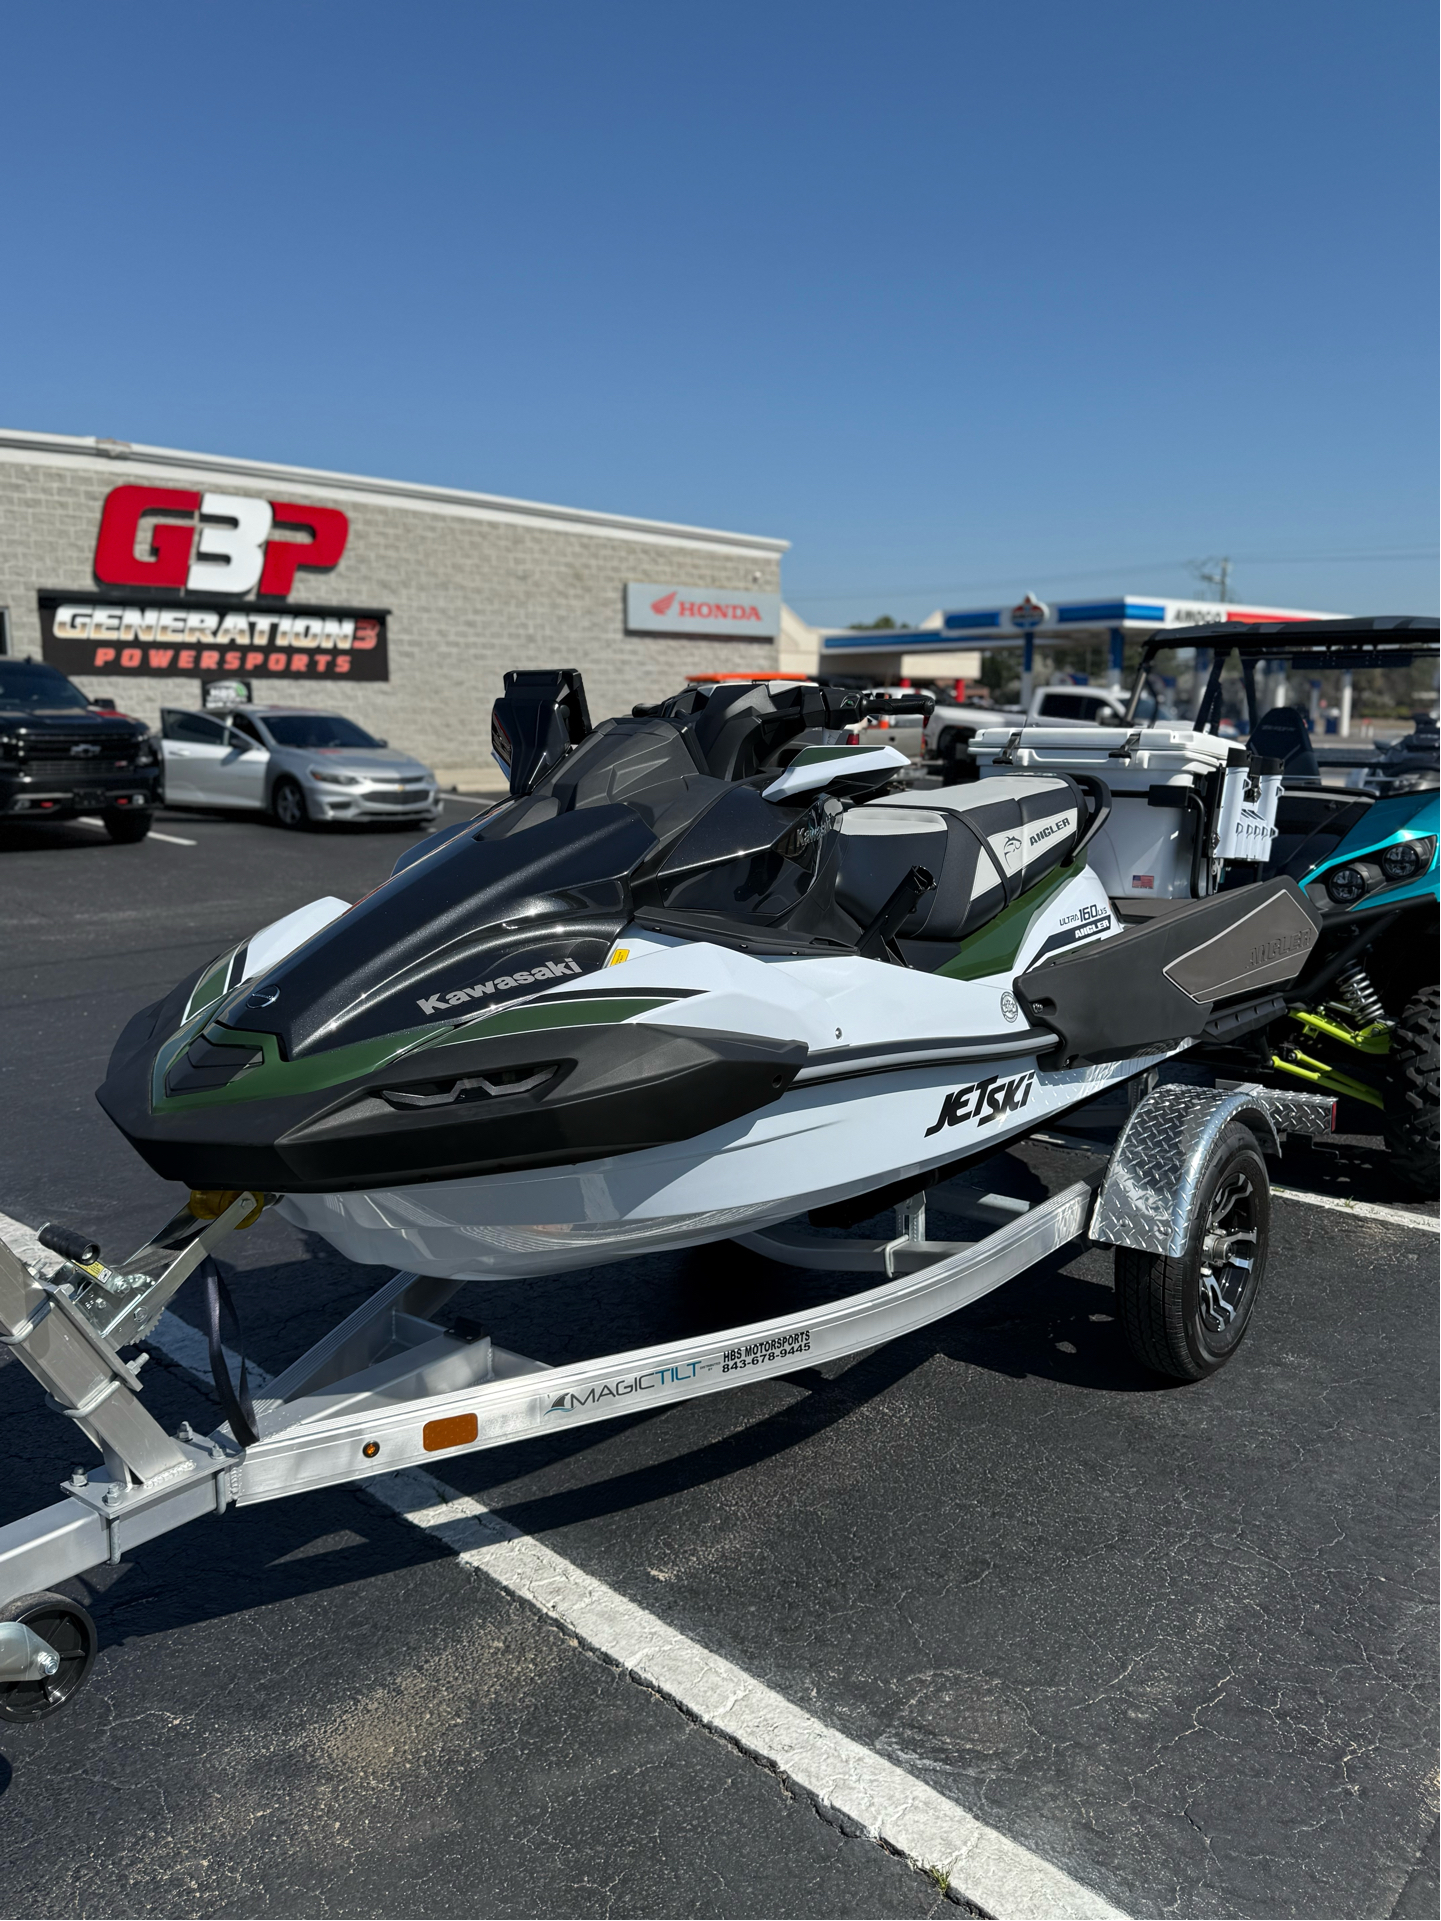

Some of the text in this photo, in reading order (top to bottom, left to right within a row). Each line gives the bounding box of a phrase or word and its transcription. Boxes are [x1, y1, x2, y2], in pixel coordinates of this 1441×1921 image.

[94, 485, 349, 596] G3P
[678, 601, 762, 621] HONDA
[1172, 608, 1221, 625] AMOCO
[94, 647, 352, 673] POWERSPORTS
[1029, 817, 1070, 846] ANGLER
[1058, 913, 1079, 926] ULTRA
[1079, 904, 1098, 922] 160
[1074, 919, 1109, 938] ANGLER
[1245, 928, 1311, 969] ANGLER
[416, 957, 583, 1015] Kawasaki
[722, 1342, 811, 1373] 843-678-9445
[723, 1330, 811, 1363] HBS MOTORSPORTS
[570, 1360, 702, 1409] MAGICTILT
